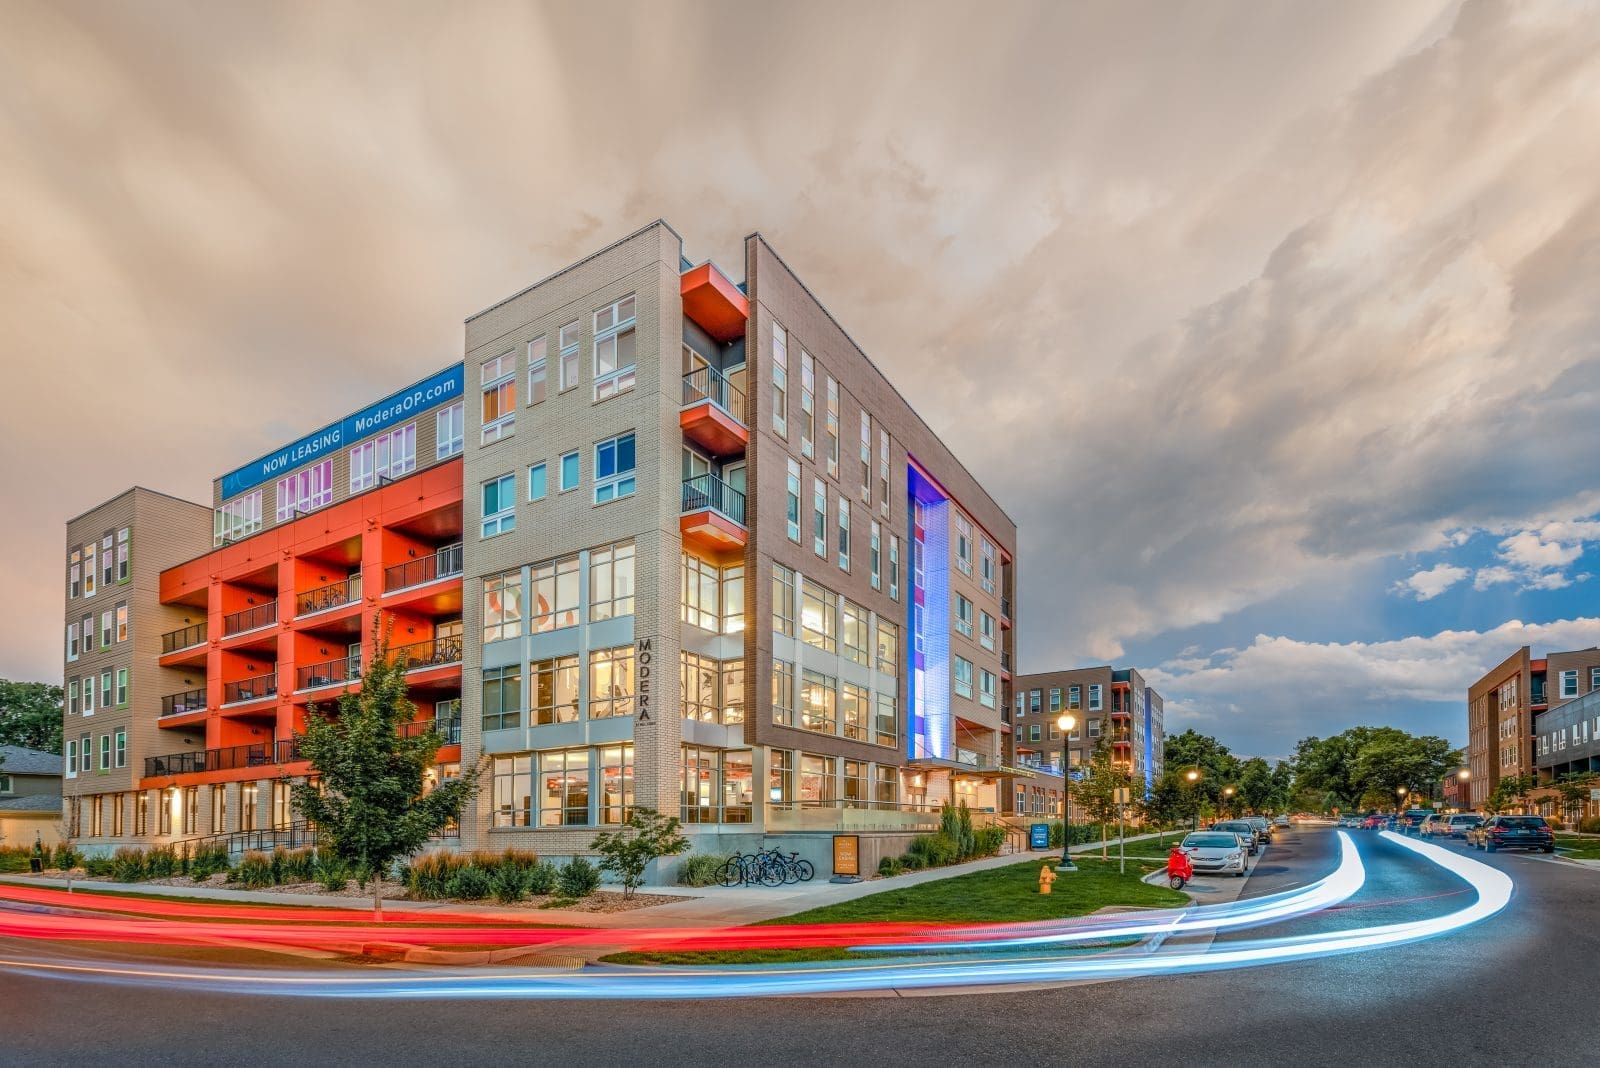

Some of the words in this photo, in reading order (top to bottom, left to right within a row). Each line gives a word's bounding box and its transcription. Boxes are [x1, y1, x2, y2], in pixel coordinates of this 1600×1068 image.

[263, 453, 289, 475] NOW
[291, 430, 340, 462] LEASING
[355, 379, 455, 433] ModeraOP.com
[639, 638, 652, 720] MODERA
